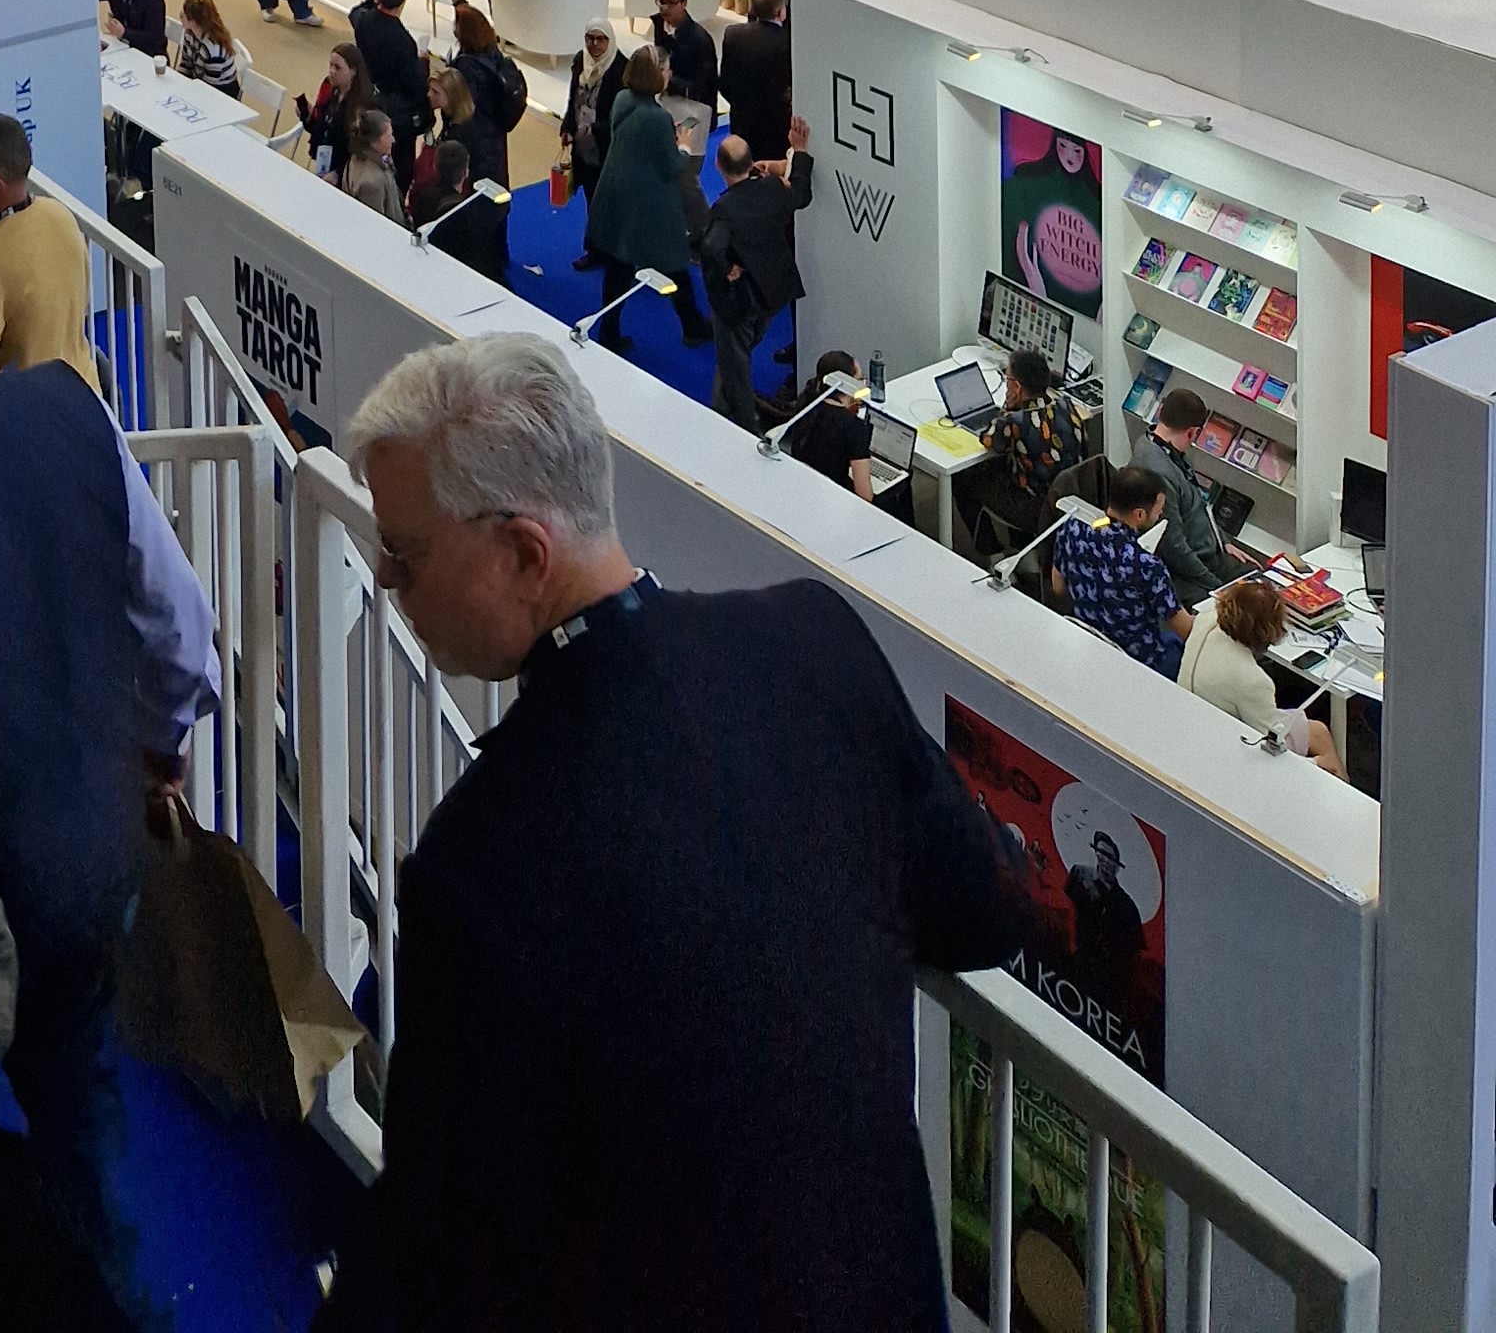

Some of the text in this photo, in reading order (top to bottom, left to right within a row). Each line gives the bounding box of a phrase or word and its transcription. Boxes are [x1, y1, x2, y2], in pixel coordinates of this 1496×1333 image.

[16, 76, 32, 113] UK
[163, 176, 183, 197] 6E21
[1046, 222, 1098, 259] WITCH
[1058, 210, 1083, 234] BIG
[1040, 237, 1100, 278] ENERGY
[234, 254, 322, 360] MANGA
[236, 305, 321, 406] TAROT
[1037, 961, 1148, 1070] KOREA
